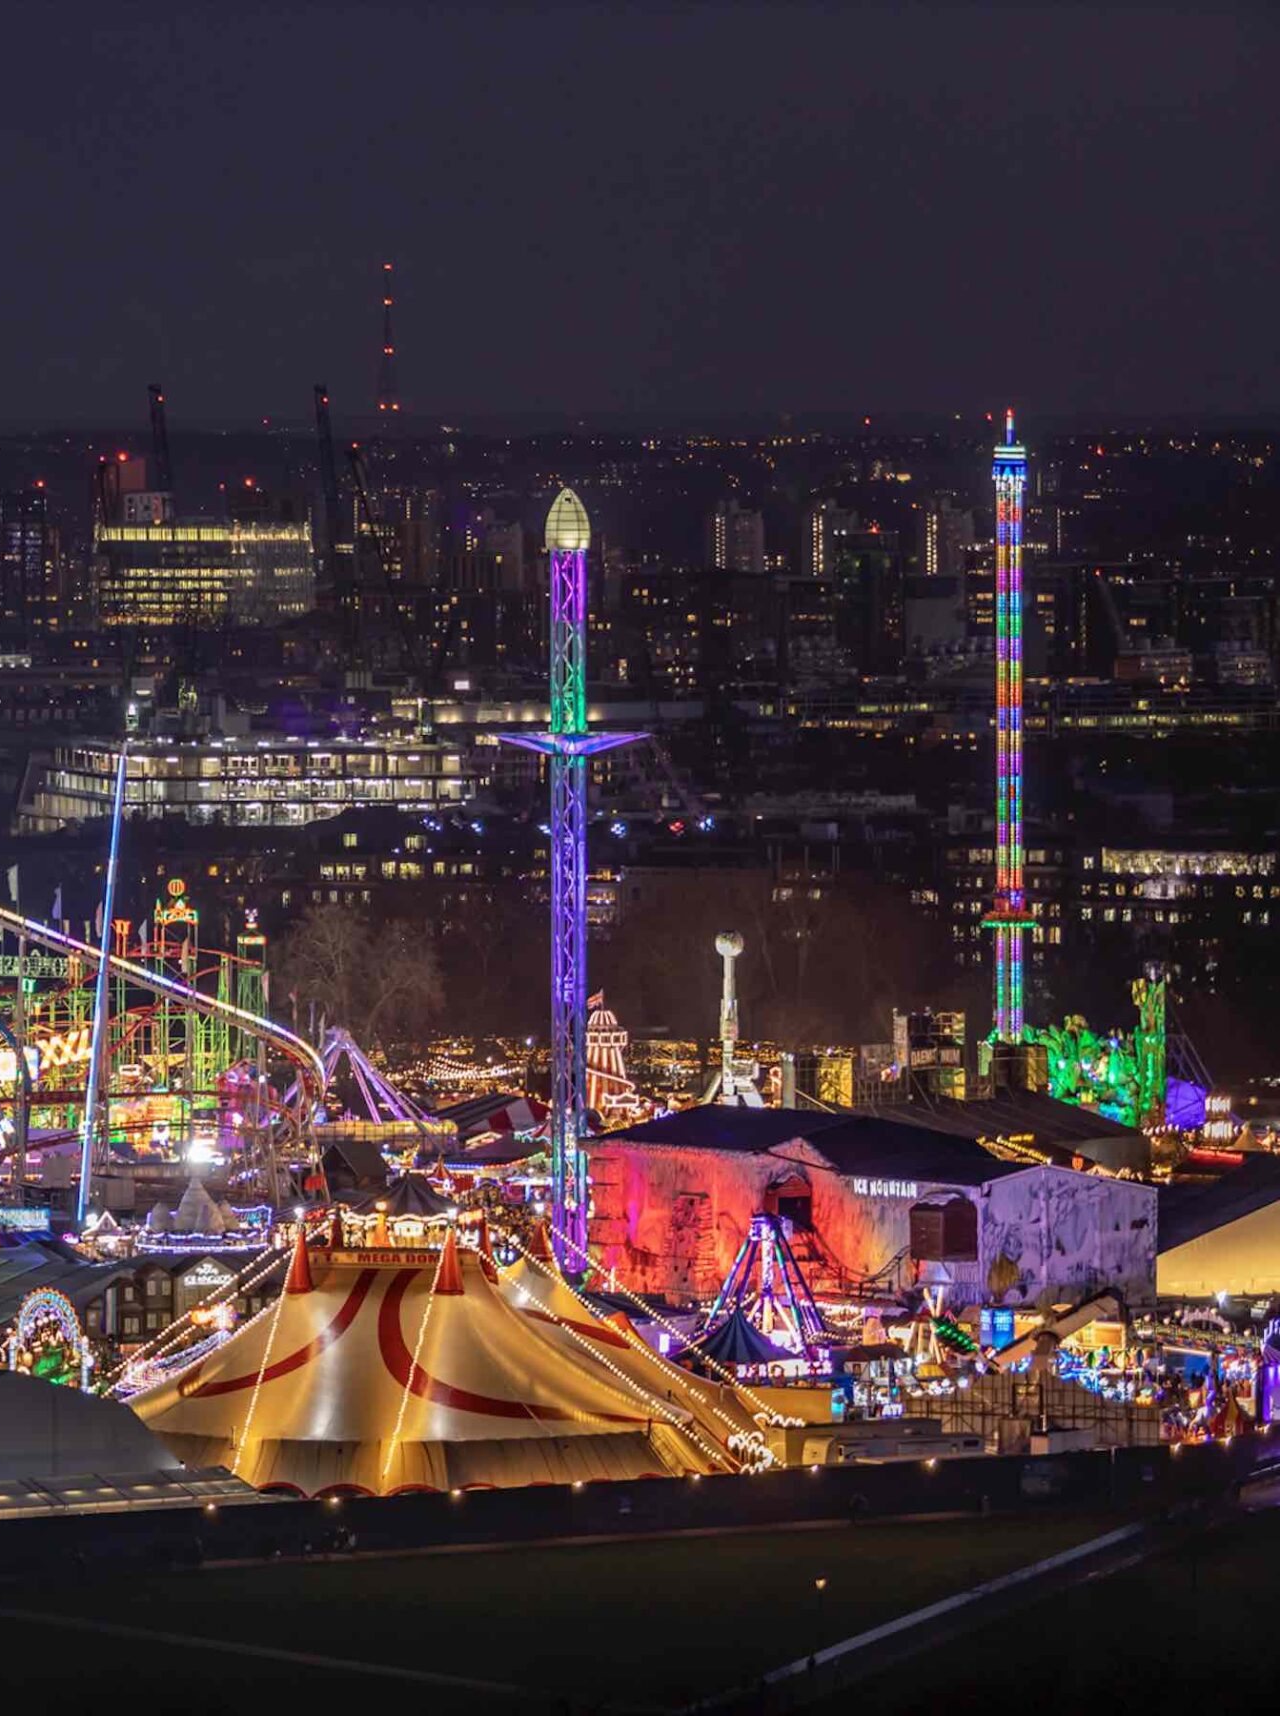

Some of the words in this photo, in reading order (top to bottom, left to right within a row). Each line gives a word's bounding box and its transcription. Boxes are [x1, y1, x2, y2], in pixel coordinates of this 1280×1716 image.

[36, 1029, 92, 1069] XXL
[853, 1178, 868, 1194] ICE
[870, 1179, 917, 1198] MOUNTAIN
[358, 1253, 401, 1263] MEGA
[406, 1253, 441, 1263] DOM
